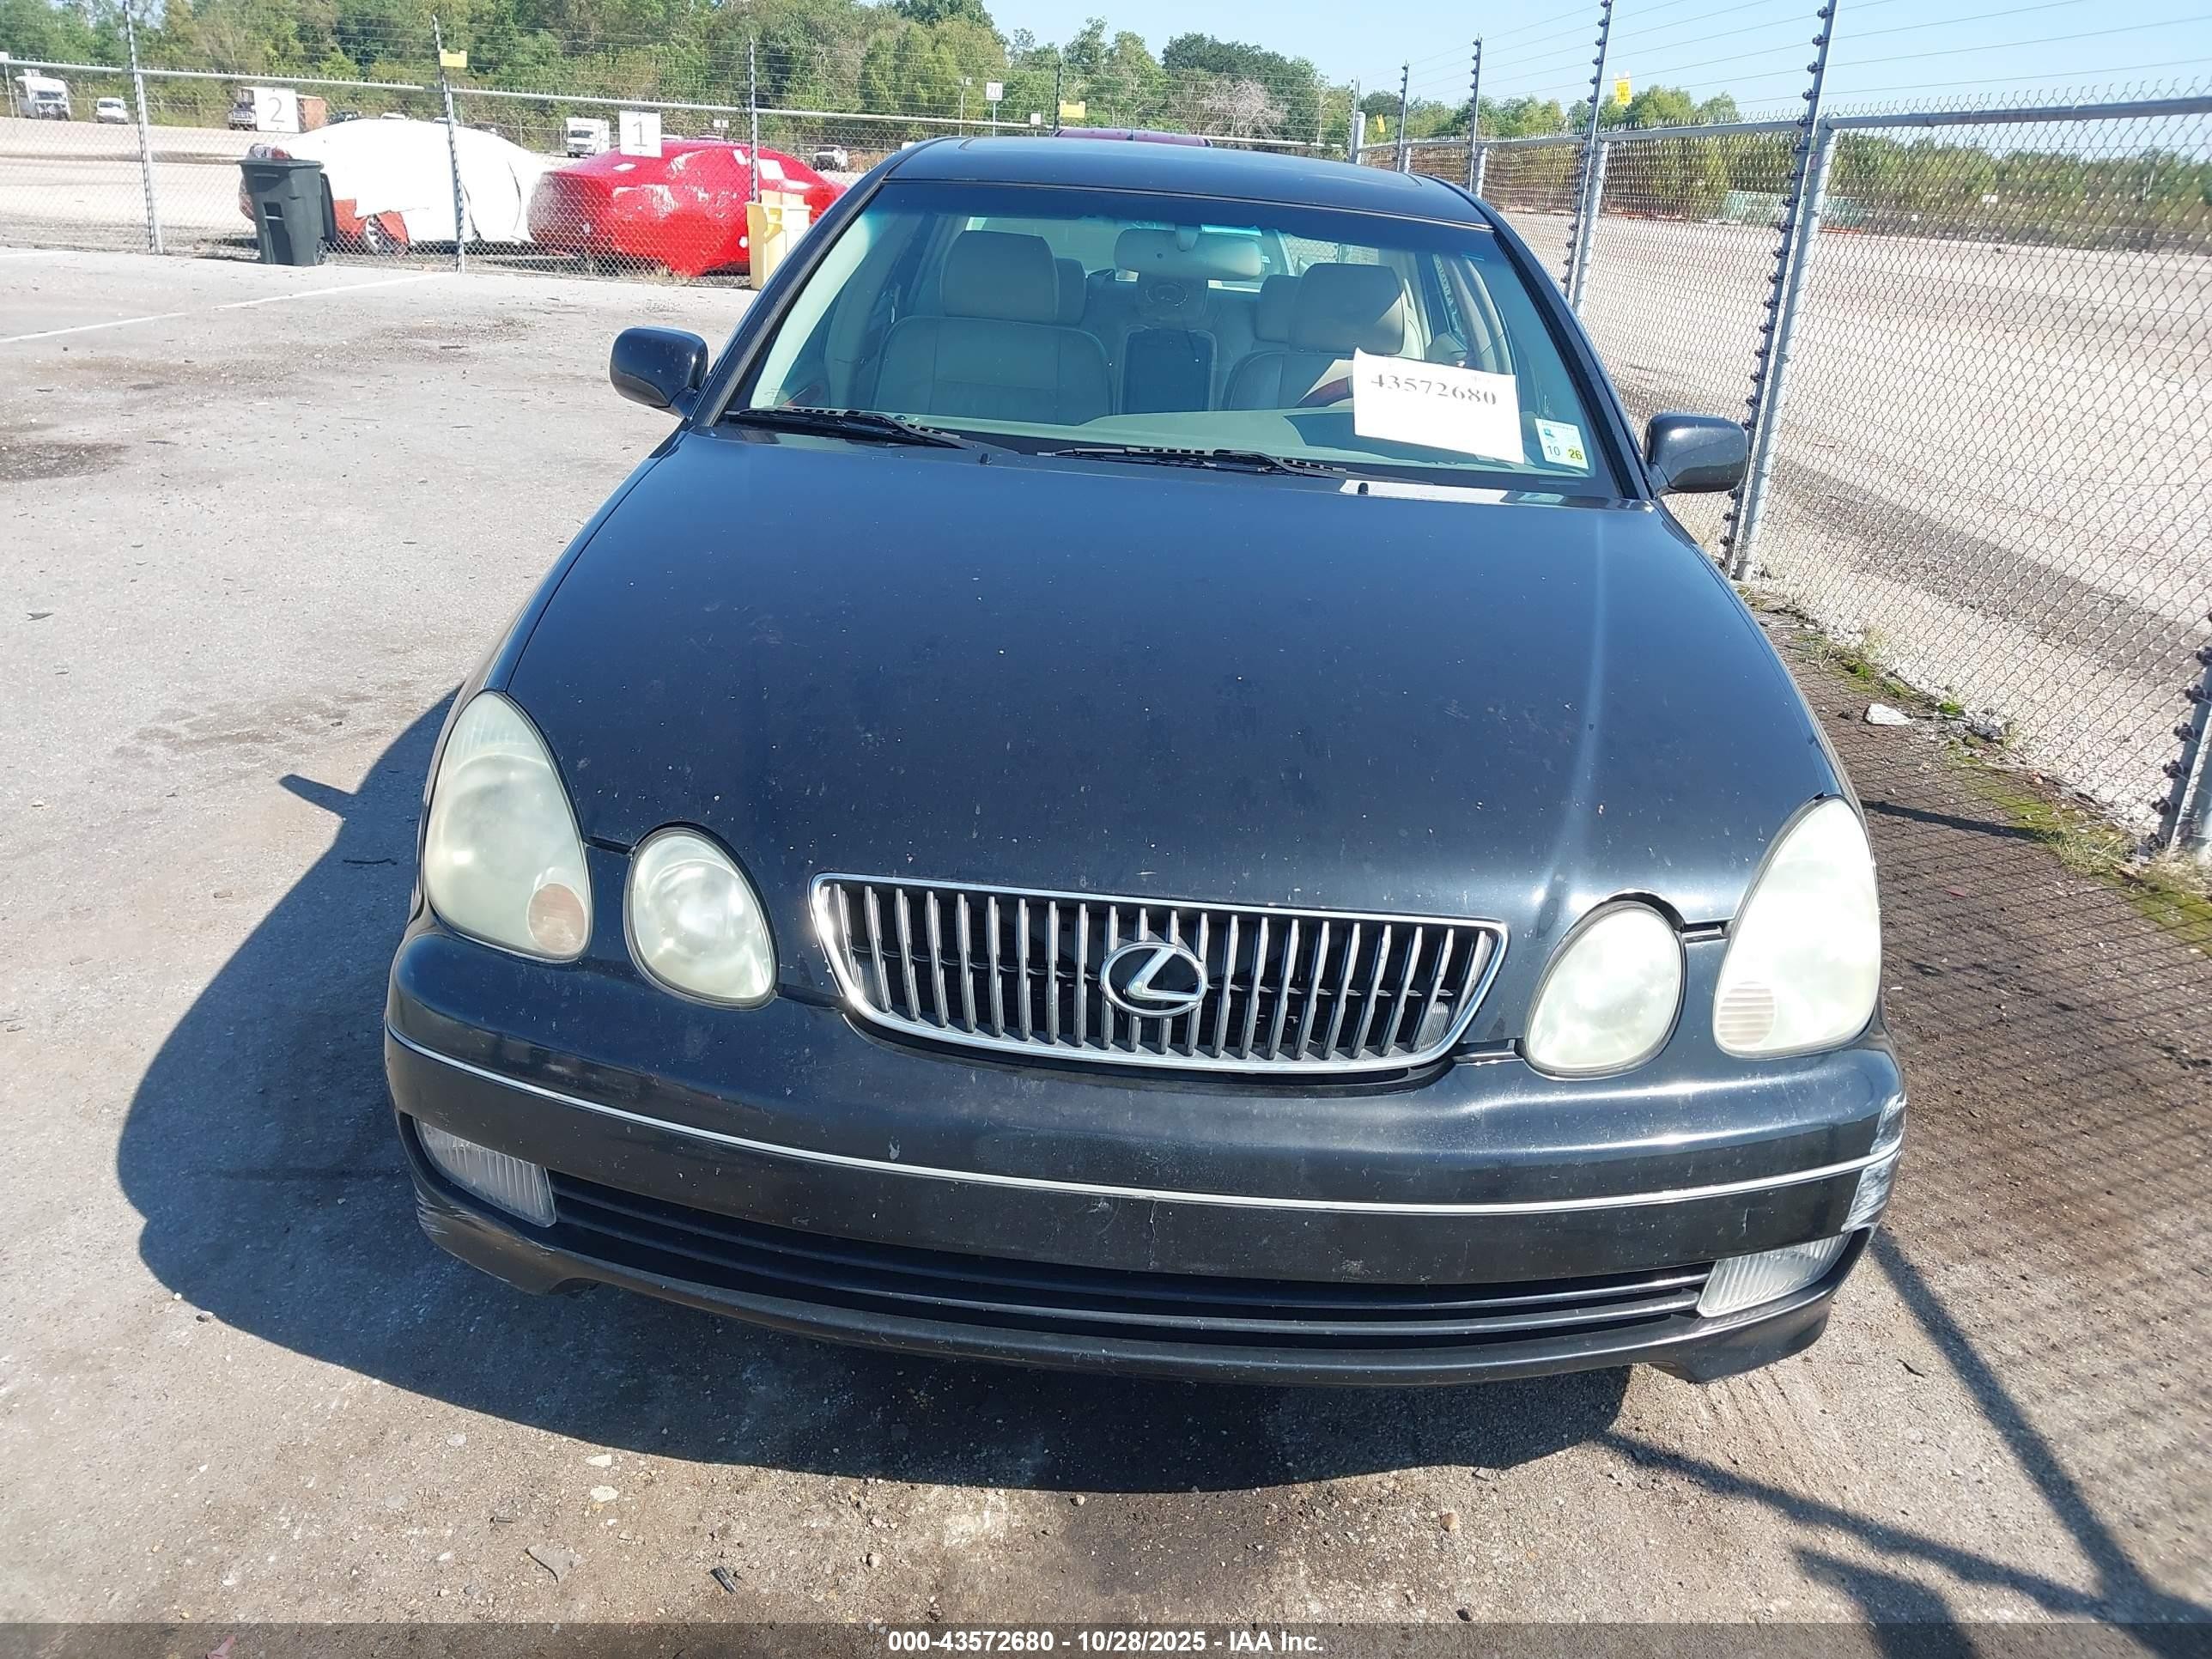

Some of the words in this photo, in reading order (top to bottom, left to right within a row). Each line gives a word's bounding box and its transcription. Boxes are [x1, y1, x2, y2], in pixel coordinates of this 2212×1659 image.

[988, 86, 1001, 98] 20
[267, 96, 285, 123] 2
[633, 120, 647, 147] 1
[1370, 374, 1497, 405] 43572680
[1547, 445, 1560, 456] 10
[1568, 448, 1583, 460] 26
